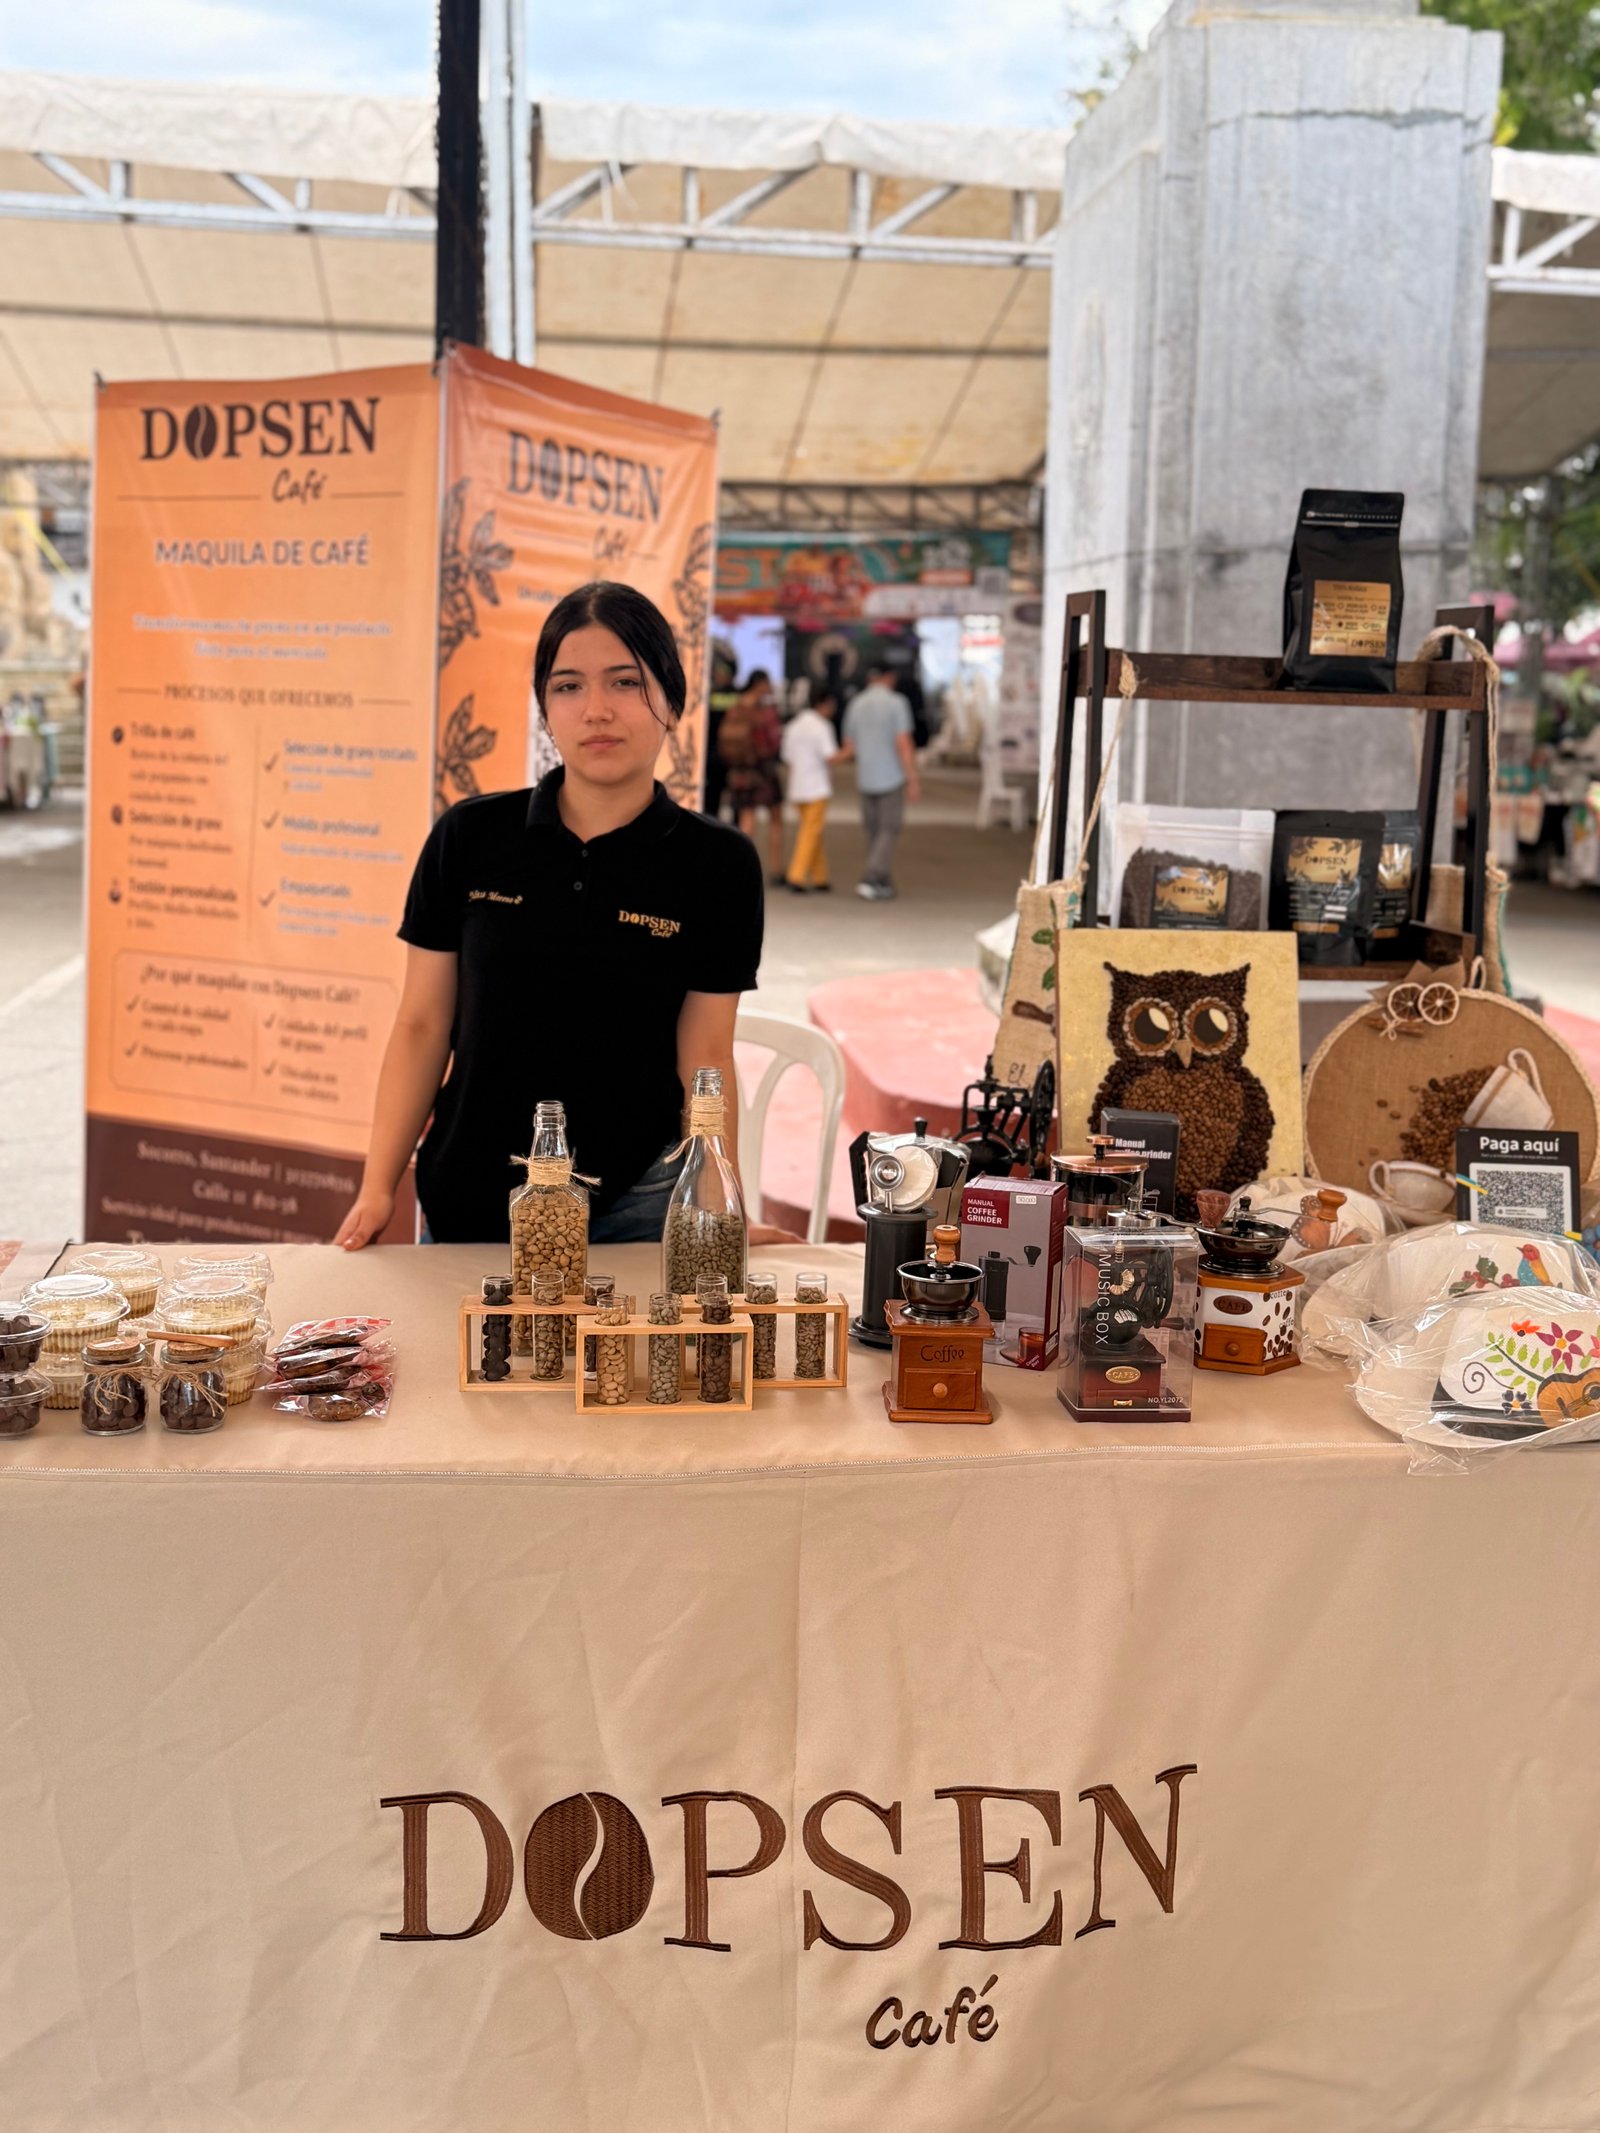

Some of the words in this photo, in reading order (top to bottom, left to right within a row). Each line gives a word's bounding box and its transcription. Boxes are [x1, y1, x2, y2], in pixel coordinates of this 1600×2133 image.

[140, 397, 381, 461] DOPSEN
[271, 467, 328, 505] Café
[507, 428, 665, 523] DOPSEN
[154, 540, 267, 569] MAQUILA
[272, 541, 303, 566] DE
[310, 534, 369, 566] CAFÉ
[163, 684, 235, 704] PROCESOS
[238, 687, 267, 708] QUE
[270, 689, 354, 710] OFRECEMOS
[1305, 856, 1347, 866] DOPSEN
[619, 910, 681, 933] DOPSEN
[1115, 1138, 1145, 1148] Manual
[1480, 1136, 1520, 1154] Paga
[1523, 1138, 1560, 1155] aquí
[967, 1198, 994, 1207] MANUAL
[967, 1206, 997, 1216] COFFEE
[966, 1214, 1002, 1224] GRINDER
[1096, 1254, 1111, 1307] MUSIC
[1095, 1312, 1109, 1344] BOX
[920, 1344, 965, 1363] Coffee
[379, 1764, 1198, 1952] DOPSEN
[865, 1973, 1000, 2049] Café
